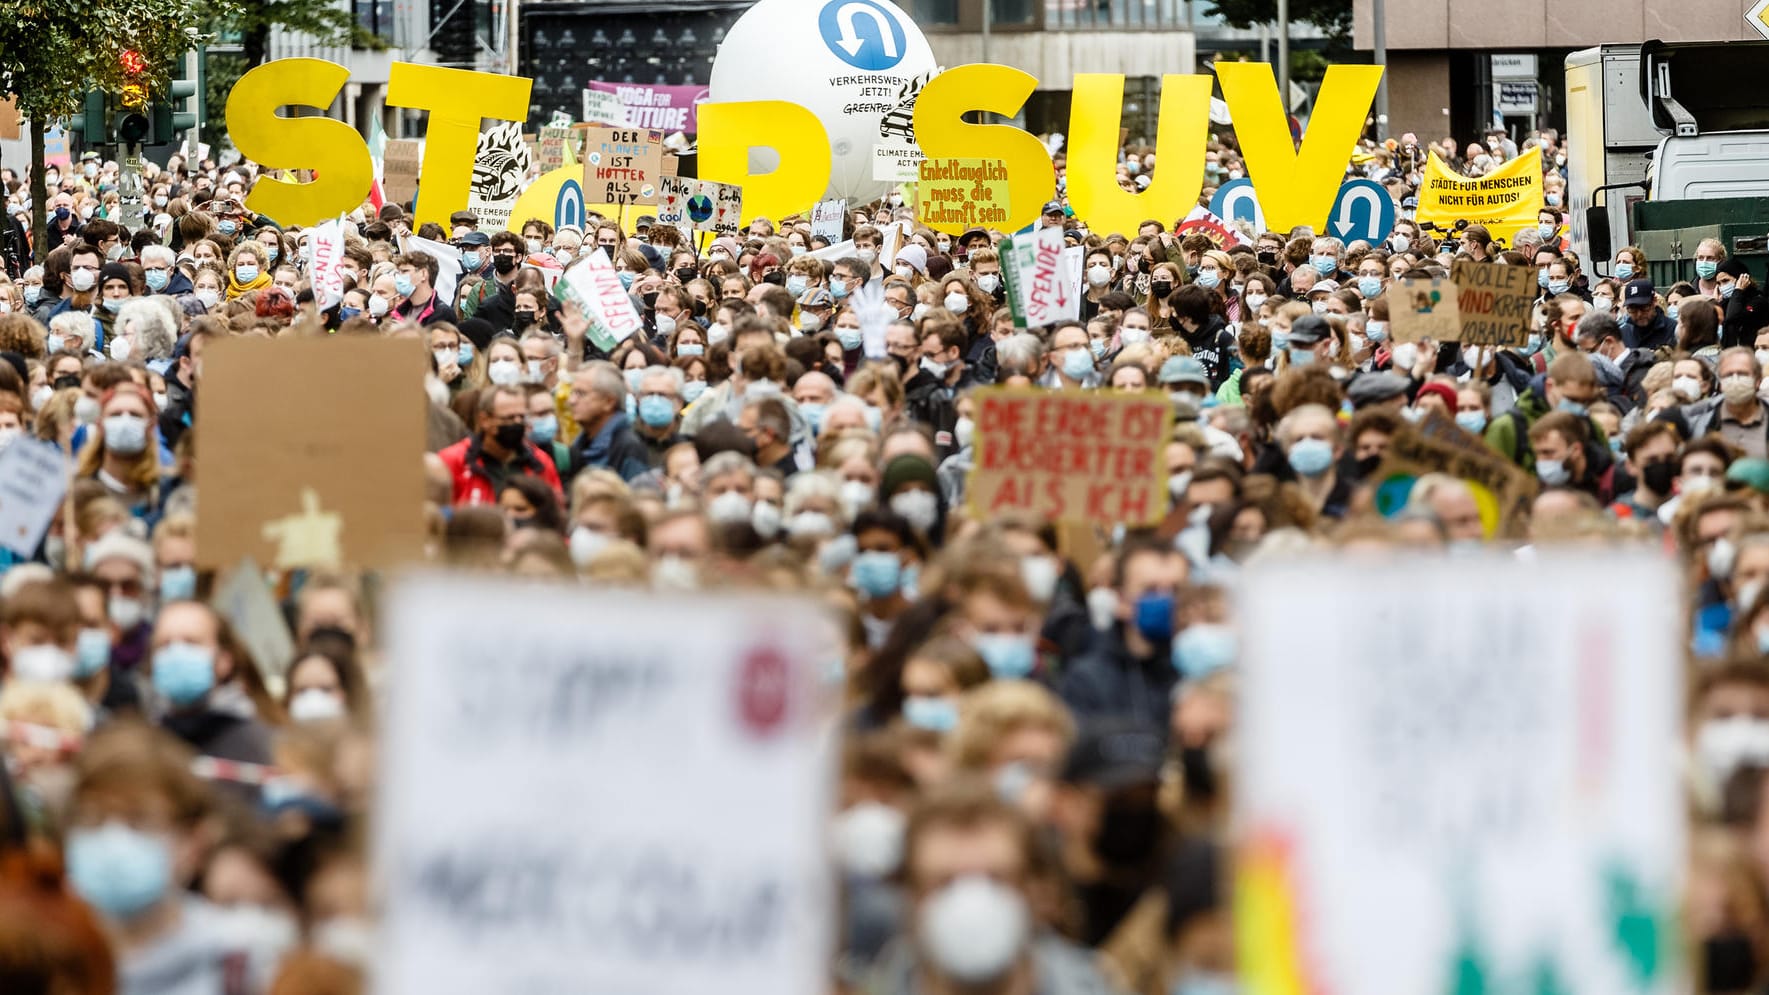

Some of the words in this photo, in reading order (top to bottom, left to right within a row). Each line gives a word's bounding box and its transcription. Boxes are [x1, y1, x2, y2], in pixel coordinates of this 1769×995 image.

[859, 88, 892, 96] JETZT!
[843, 103, 892, 115] GREENPEA
[612, 131, 638, 142] DER
[601, 143, 649, 156] PLANET
[877, 149, 908, 157] CLIMATE
[913, 62, 1385, 235] SUV
[611, 157, 633, 167] IST
[596, 168, 645, 181] HOTTER
[920, 160, 1008, 188] Enkeltauglich
[606, 182, 630, 193] ALS
[1480, 176, 1532, 190] MENSCHEN
[661, 178, 690, 197] Make
[718, 188, 741, 203] Earth
[931, 187, 965, 202] muss
[971, 184, 993, 201] die
[1439, 195, 1464, 205] NICHT
[1466, 194, 1485, 206] FÜR
[1487, 192, 1520, 204] AUTOS!
[923, 201, 976, 224] Zukunft
[979, 203, 1006, 223] sein
[659, 208, 683, 222] cool
[711, 222, 738, 232] again
[1028, 239, 1060, 320] SPENDE
[1465, 264, 1518, 289] VOLLE
[980, 398, 1026, 434] DIE
[1119, 404, 1166, 441] IST
